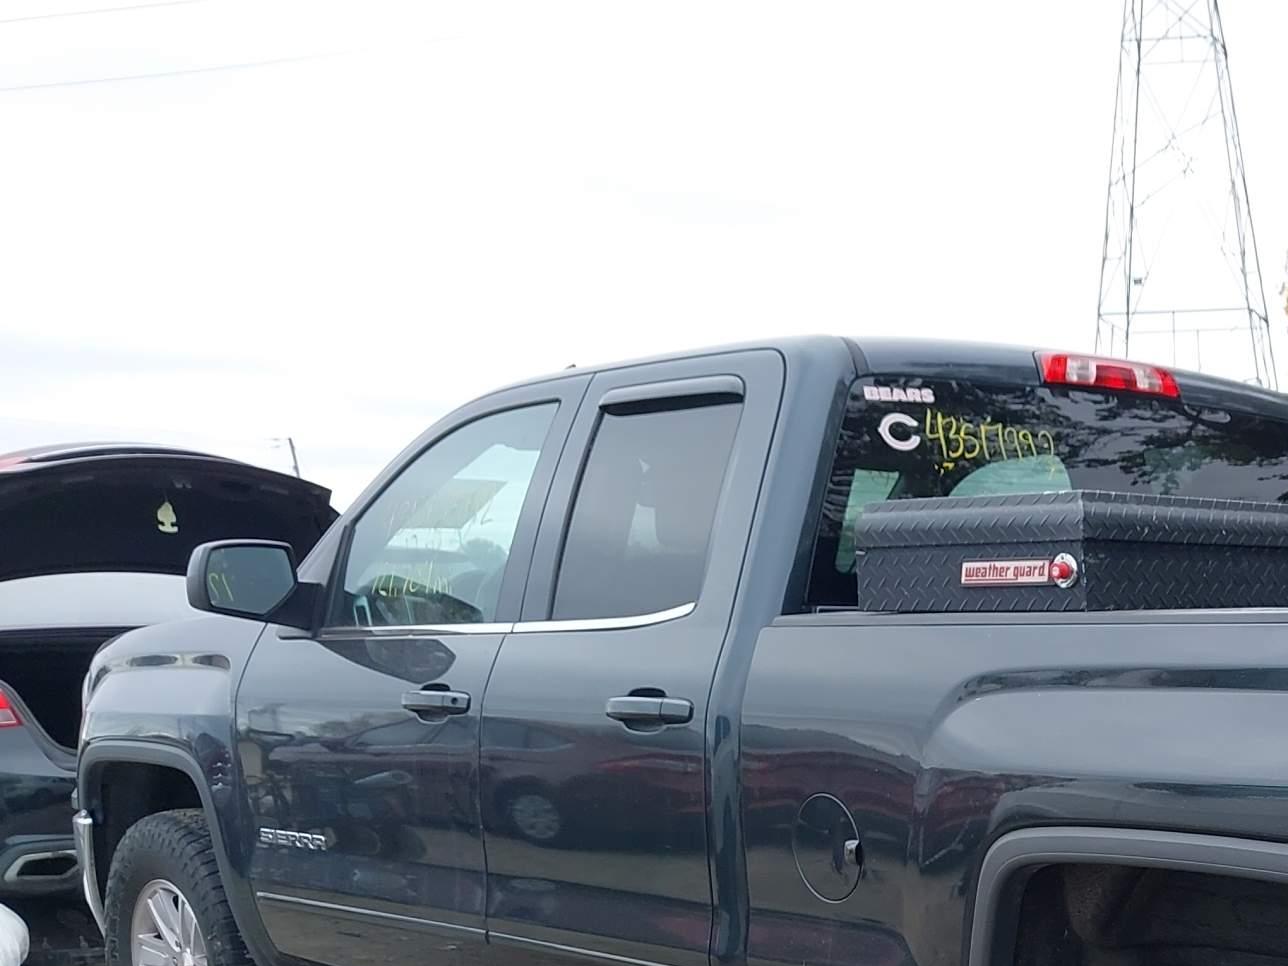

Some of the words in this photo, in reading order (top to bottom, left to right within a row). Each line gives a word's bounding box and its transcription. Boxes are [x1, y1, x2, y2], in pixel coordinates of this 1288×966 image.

[863, 384, 935, 403] BEARS
[964, 564, 1010, 579] weather
[1012, 563, 1046, 580] guard
[259, 826, 327, 851] SIERRA
